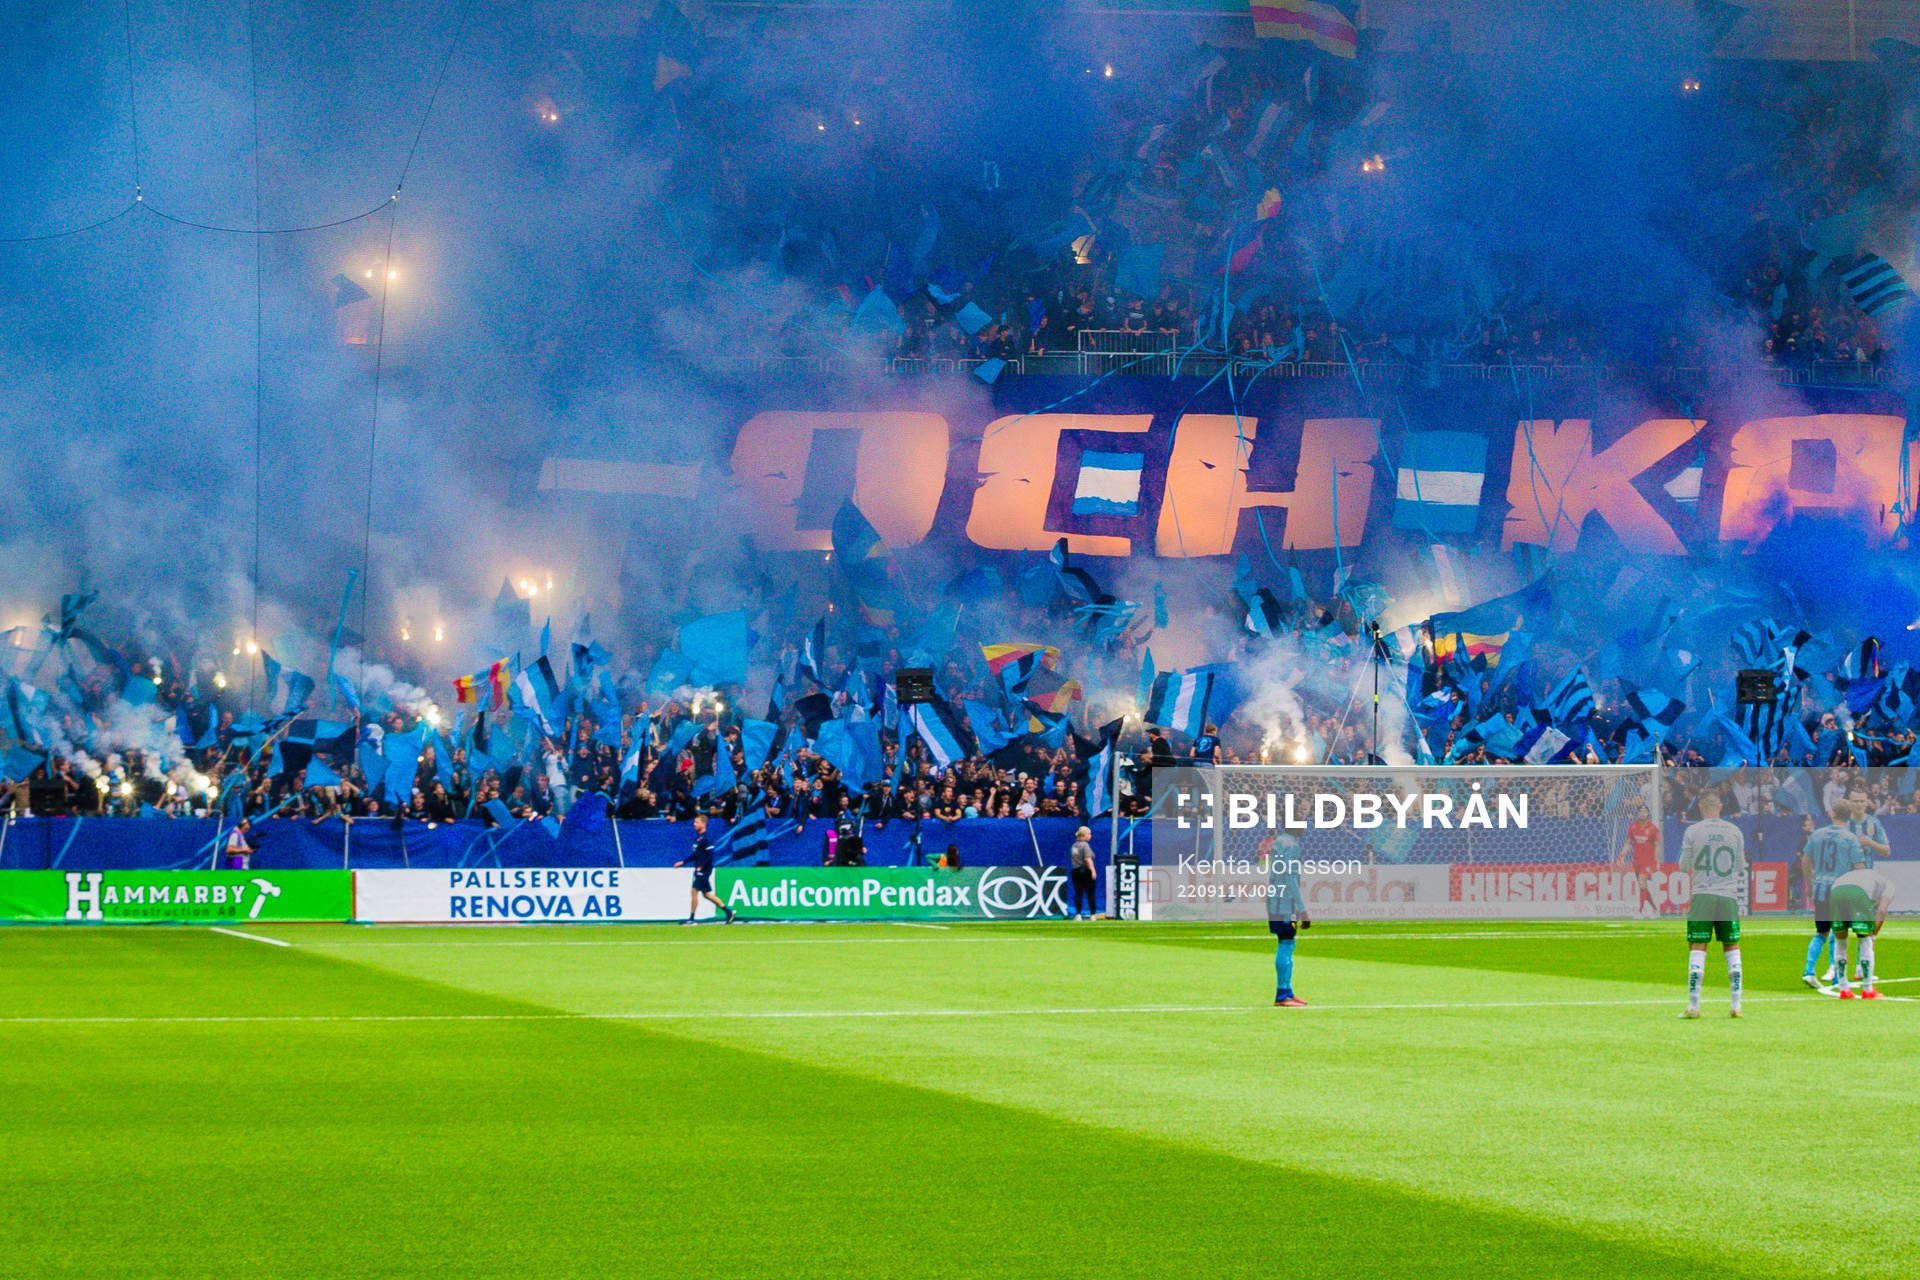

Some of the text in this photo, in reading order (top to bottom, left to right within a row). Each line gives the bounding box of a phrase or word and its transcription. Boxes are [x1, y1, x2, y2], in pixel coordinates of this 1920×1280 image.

[1694, 844, 1736, 878] 40
[1819, 840, 1838, 872] 13
[450, 870, 619, 888] PALLSERVICE
[728, 879, 971, 907] AudicomPendax
[1119, 862, 1137, 920] SELECT
[1461, 871, 1567, 903] HUSKI
[65, 872, 245, 921] HAMMARBY
[112, 906, 236, 917] Construction AB
[450, 895, 623, 918] RENOVA AB
